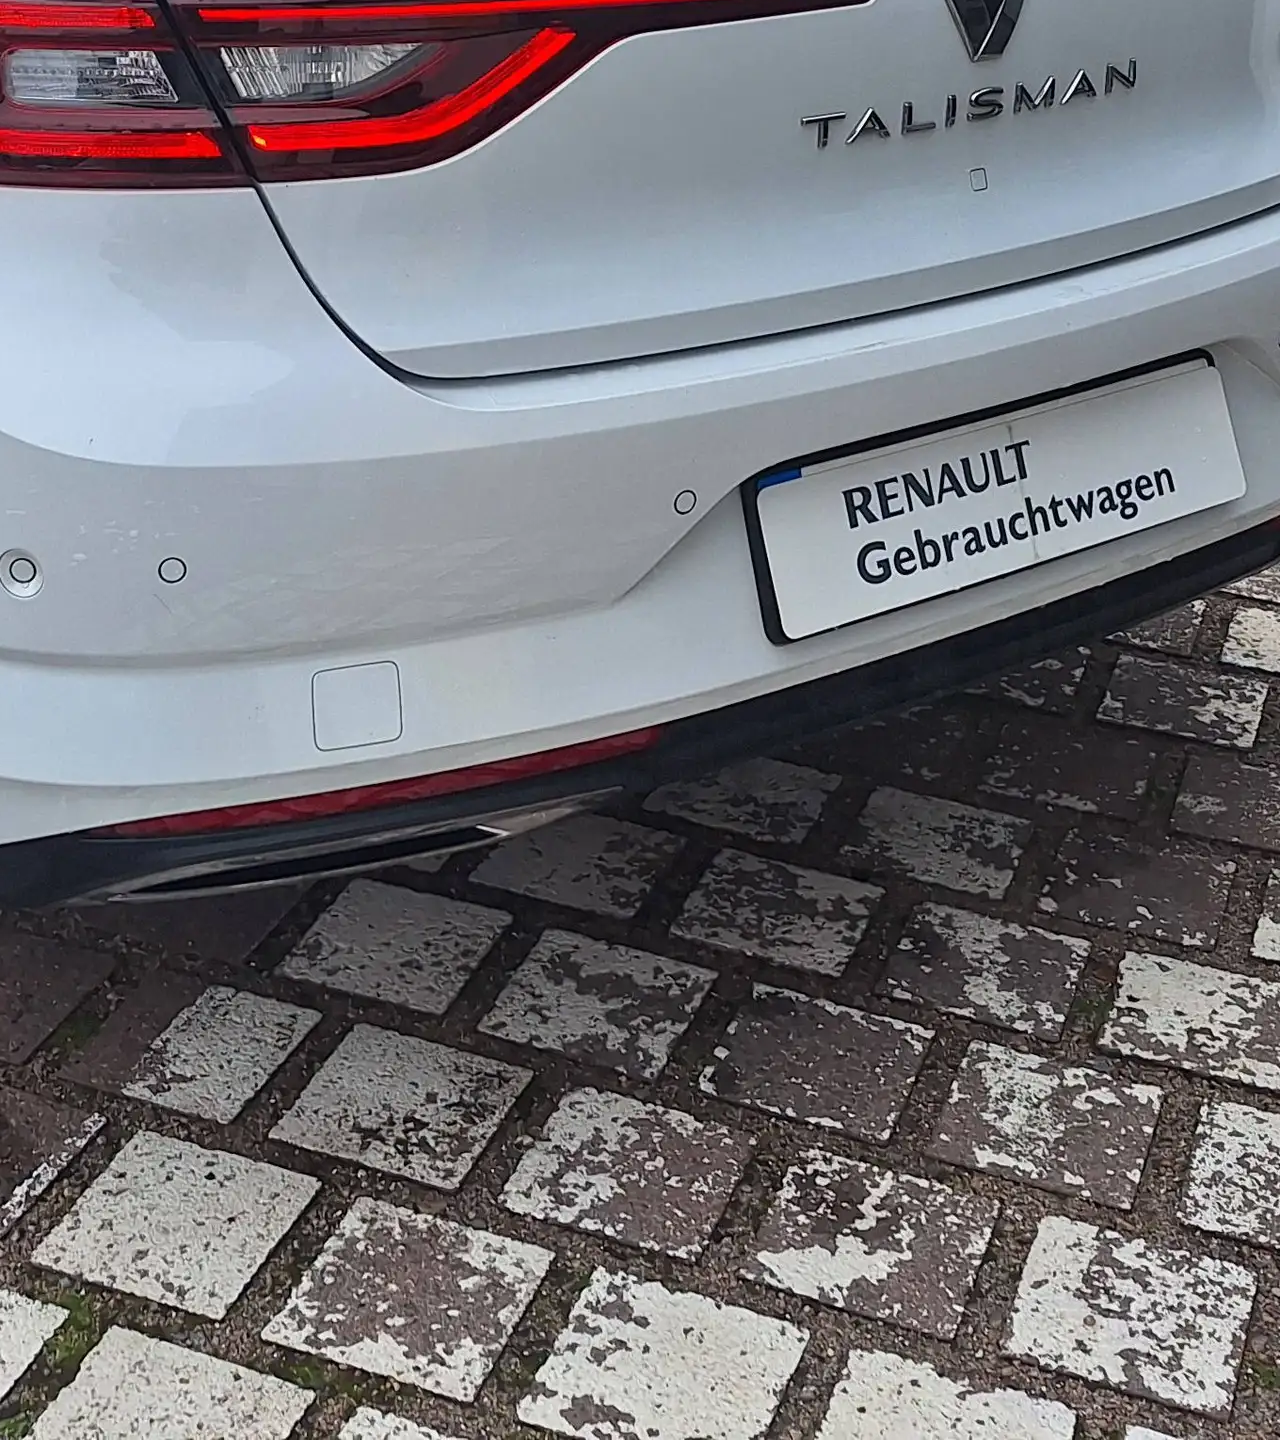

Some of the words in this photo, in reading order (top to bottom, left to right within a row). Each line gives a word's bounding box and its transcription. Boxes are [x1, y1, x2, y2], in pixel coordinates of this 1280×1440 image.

[801, 58, 1138, 148] TALISMAN
[841, 439, 1031, 530] RENAULT
[856, 466, 1177, 585] Gebrauchtwagen
